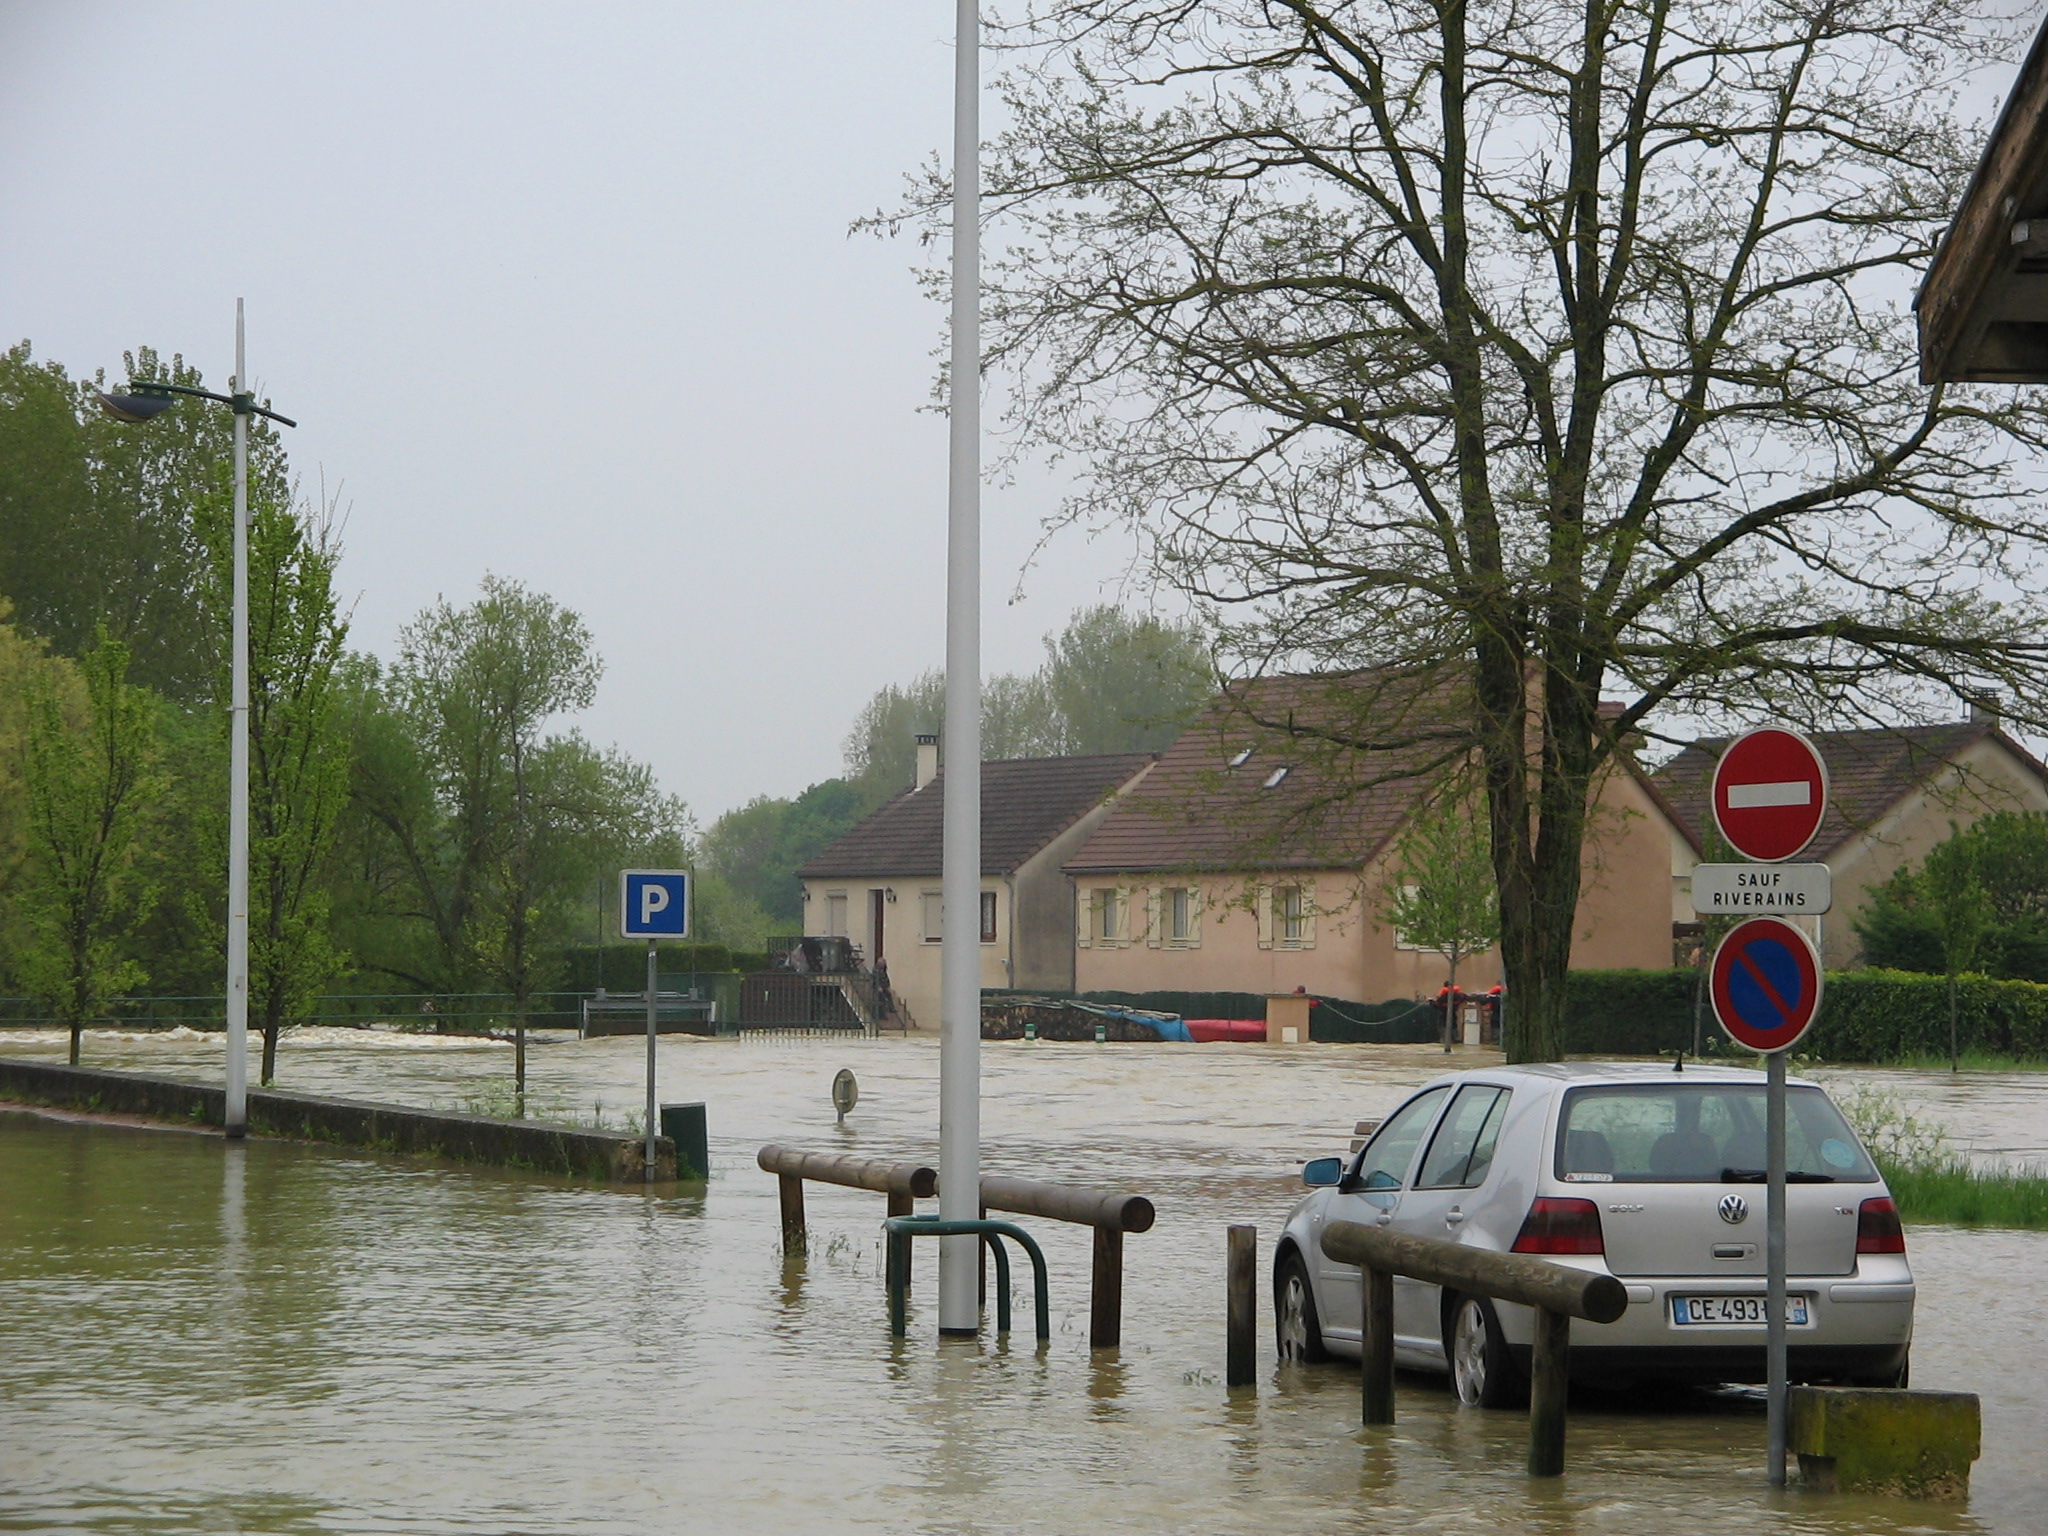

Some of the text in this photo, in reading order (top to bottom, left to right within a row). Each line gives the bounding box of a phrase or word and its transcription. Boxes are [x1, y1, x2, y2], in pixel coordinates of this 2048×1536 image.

[1737, 873, 1782, 887] SAUF
[641, 884, 670, 924] P
[1713, 892, 1806, 906] RIVERAINS
[1608, 1203, 1645, 1213] GOLF
